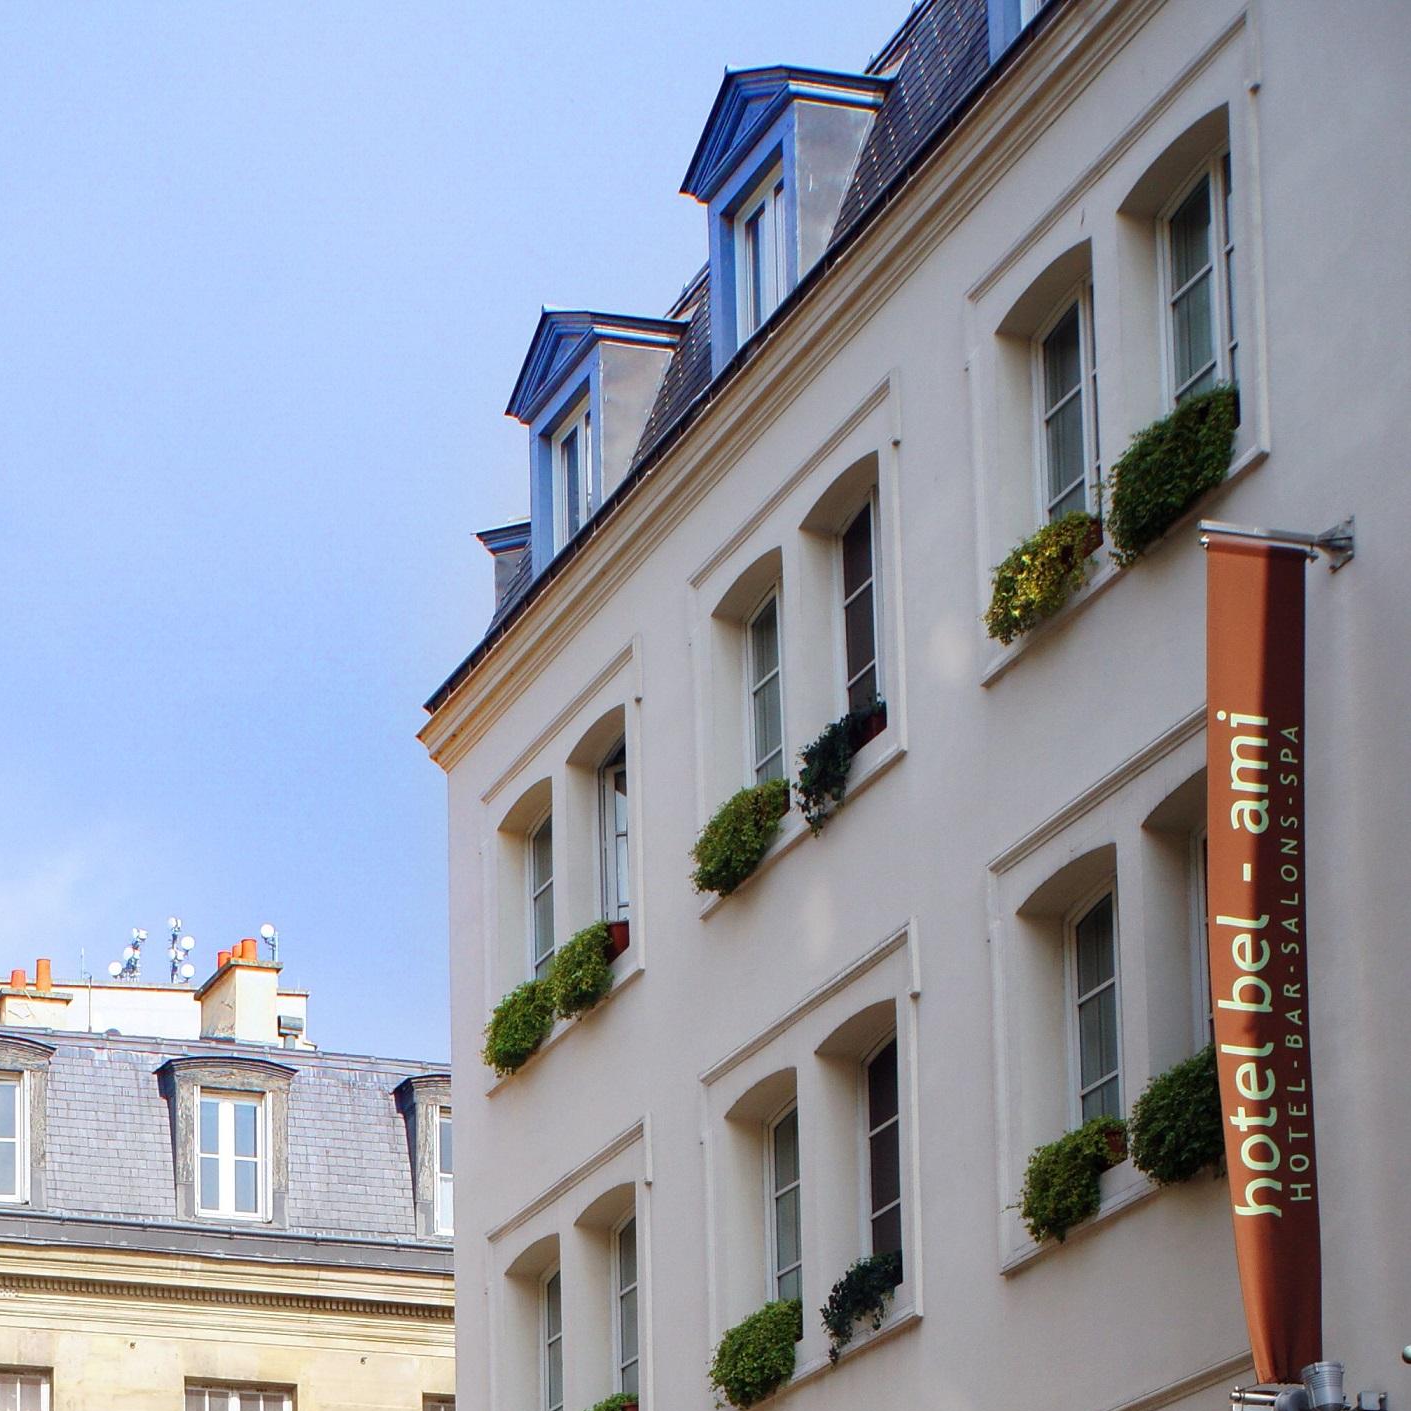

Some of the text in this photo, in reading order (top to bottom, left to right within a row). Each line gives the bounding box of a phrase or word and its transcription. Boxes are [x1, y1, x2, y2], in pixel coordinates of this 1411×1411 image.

[1216, 710, 1270, 834] ami
[1216, 914, 1273, 1013] bel
[1220, 1042, 1282, 1218] hotel
